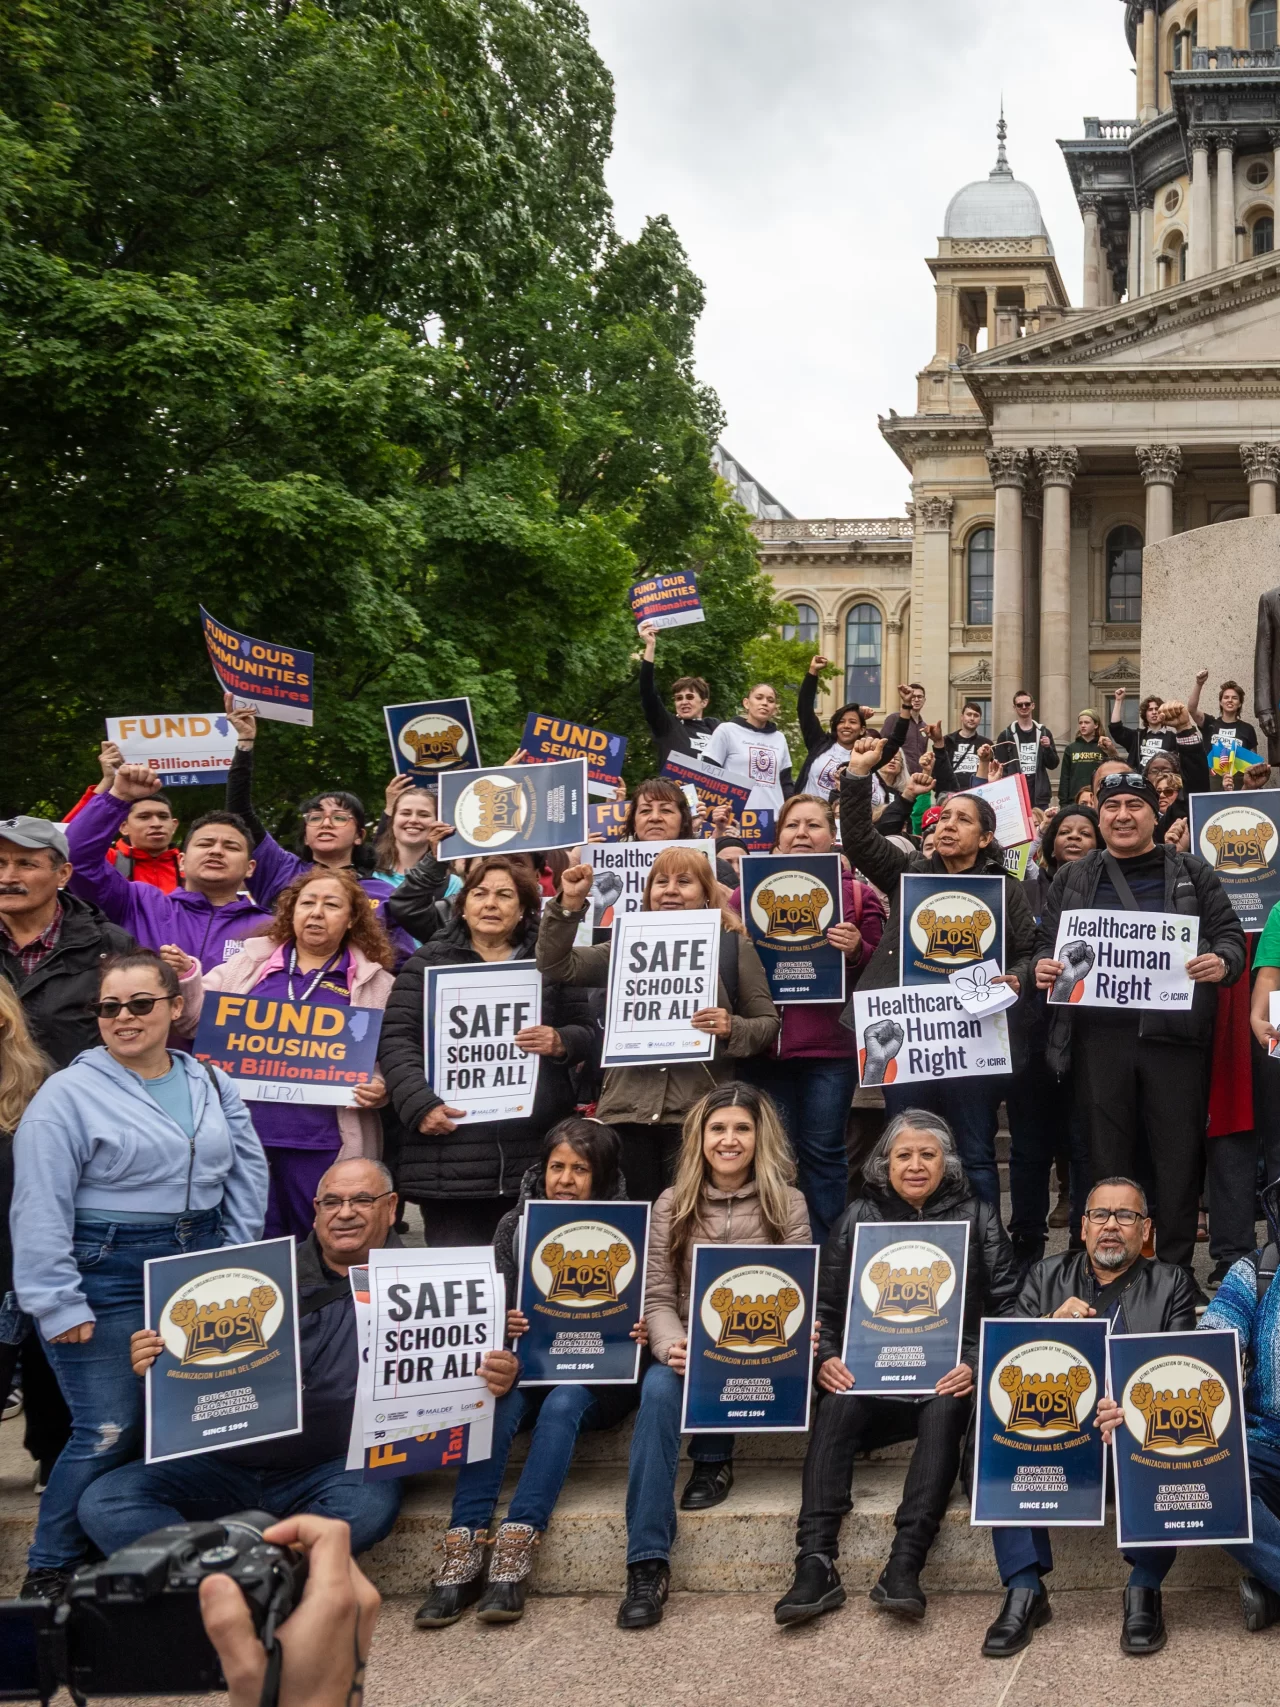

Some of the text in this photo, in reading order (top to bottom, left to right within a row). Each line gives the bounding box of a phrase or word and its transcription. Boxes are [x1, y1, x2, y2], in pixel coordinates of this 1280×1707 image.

[633, 575, 686, 595] FUND OUR
[631, 584, 696, 609] COMMUNITIES
[644, 598, 699, 614] Billionaires
[205, 618, 294, 667] FUND OUR
[118, 717, 212, 740] FUND
[533, 716, 609, 752] FUND
[420, 739, 453, 756] LOS
[540, 741, 606, 767] SENIORS
[148, 755, 232, 770] Billionaire
[665, 763, 749, 800] Billionaires Tax
[493, 793, 508, 825] LOS
[1224, 841, 1258, 857] LOS
[775, 909, 812, 924] LOS
[935, 928, 974, 945] LOS
[1067, 915, 1191, 943] Healthcare is a
[628, 938, 708, 974] SAFE
[1097, 942, 1172, 972] Human
[625, 976, 705, 997] SCHOOLS
[1095, 971, 1153, 1005] Right
[1170, 992, 1189, 1001] ICIRR
[214, 995, 346, 1036] FUND
[448, 1002, 531, 1040] SAFE
[622, 1000, 662, 1022] FOR
[905, 1018, 983, 1043] Human
[226, 1033, 346, 1061] HOUSING
[446, 1042, 530, 1065] SCHOOLS
[653, 1040, 676, 1049] MALDEF
[239, 1057, 369, 1084] Billionaires
[908, 1047, 968, 1076] Right
[986, 1057, 1007, 1067] ICIRR
[446, 1065, 528, 1091] FOR ALL
[561, 1266, 607, 1285] LOS
[387, 1279, 488, 1323] SAFE
[888, 1282, 929, 1301] LOS
[198, 1316, 251, 1343] LOS
[731, 1310, 776, 1331] LOS
[385, 1322, 487, 1353] SCHOOLS
[167, 1349, 281, 1380] ORGANIZACION LATINA DEL SUROESTE
[383, 1357, 433, 1386] FOR
[195, 1395, 256, 1413] ORGANIZING
[198, 1387, 252, 1403] EDUCATING
[1020, 1391, 1068, 1412] LOS
[192, 1402, 259, 1421] EMPOWERING
[425, 1405, 453, 1415] MALDEF
[1155, 1407, 1203, 1430] LOS
[203, 1421, 248, 1436] SINCE 1994
[1130, 1448, 1231, 1470] ORGANIZACION LATINA DEL SUROESTE
[1014, 1474, 1066, 1483] ORGANIZING
[1017, 1466, 1063, 1474] EDUCATING
[1010, 1483, 1068, 1491] EMPOWERING
[1156, 1492, 1209, 1501] ORGANIZING
[1159, 1484, 1206, 1493] EDUCATING
[1041, 1501, 1058, 1509] 1994
[1154, 1501, 1213, 1511] EMPOWERING
[1164, 1520, 1204, 1529] SINCE 1994
